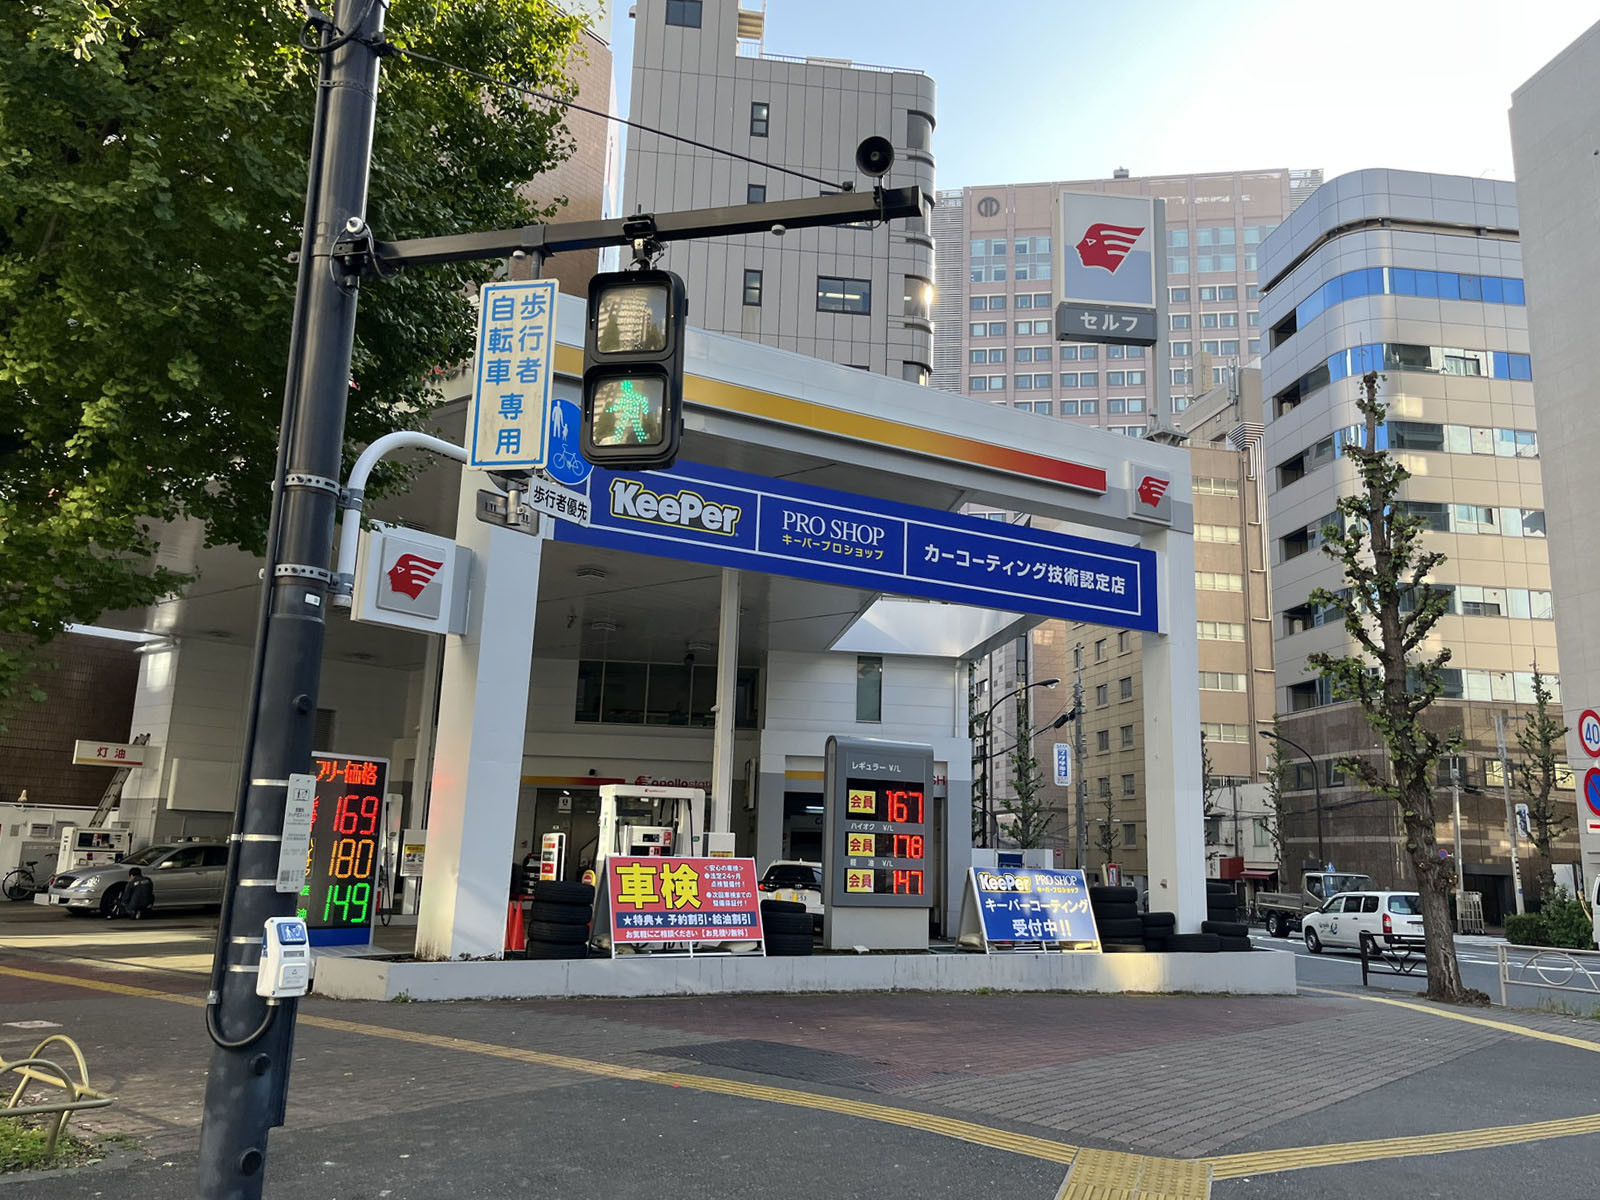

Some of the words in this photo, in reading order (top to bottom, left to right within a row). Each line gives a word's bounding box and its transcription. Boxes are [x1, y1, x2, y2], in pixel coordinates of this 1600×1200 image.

[515, 292, 547, 385] 歩行者
[1080, 312, 1138, 332] セルフ
[485, 295, 515, 386] 自転車
[494, 393, 524, 456] 専用
[533, 485, 588, 521] 歩行者優先
[611, 480, 740, 534] KeePer
[781, 510, 826, 537] PRO
[830, 519, 885, 546] SHOP
[924, 543, 1125, 596] カーコーティング技術認定店
[1585, 722, 1599, 744] 40
[97, 746, 126, 760] 灯油
[851, 761, 886, 772] レギュラー
[333, 795, 379, 835] 169
[850, 794, 874, 809] 会員
[886, 790, 924, 824] 167
[850, 822, 875, 831] ハイオク
[328, 838, 375, 879] 180
[849, 837, 873, 852] 会員
[893, 834, 923, 859] 178
[615, 862, 703, 910] 車検
[848, 873, 872, 888] 会員
[892, 869, 924, 895] 147
[979, 873, 1031, 893] KeePer
[1034, 875, 1054, 886] PRO
[1055, 875, 1078, 886] SHOP
[323, 883, 370, 923] 149
